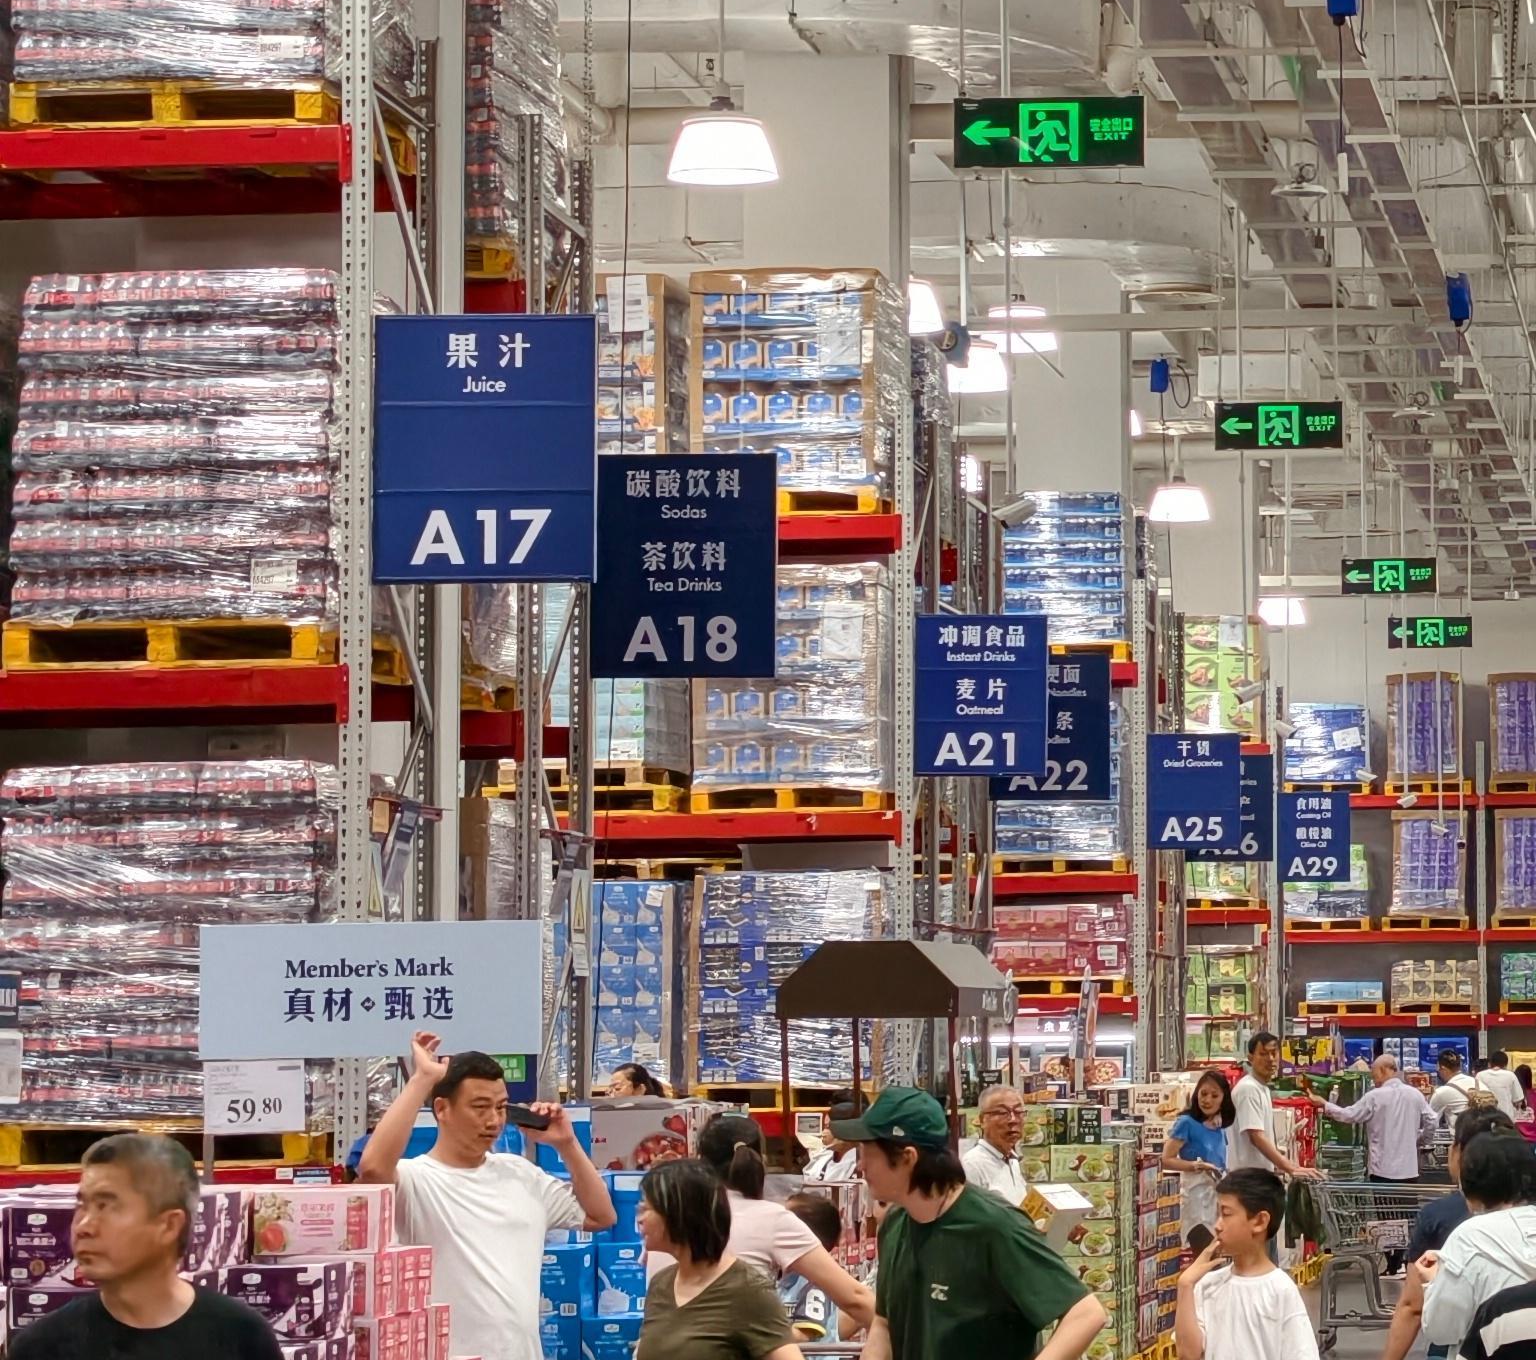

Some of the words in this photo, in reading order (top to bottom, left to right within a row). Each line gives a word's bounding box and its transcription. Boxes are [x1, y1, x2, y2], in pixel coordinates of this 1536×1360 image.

[1093, 132, 1129, 141] EXIT
[446, 333, 531, 369] 果汁
[462, 376, 507, 394] Juice
[625, 468, 741, 498] 碳酸饮料
[661, 505, 707, 520] Sodas
[410, 508, 553, 566] A17
[641, 541, 727, 572] 茶饮料
[647, 578, 675, 593] Tea
[678, 577, 723, 592] Drinks
[622, 615, 738, 663] A18
[938, 625, 1025, 648] 冲调食品
[946, 651, 981, 662] Instant
[983, 651, 1016, 662] Drinks
[956, 678, 1008, 700] 麦片
[956, 703, 1004, 715] Oatmeal
[1056, 711, 1074, 730] 条
[933, 732, 1015, 767] A21
[1160, 816, 1224, 842] A25
[1288, 856, 1338, 877] A29
[284, 957, 389, 979] Member's
[394, 955, 454, 978] Mark
[283, 987, 352, 1023] 真材
[384, 986, 454, 1021] 甄选
[227, 1097, 282, 1124] 59.80
